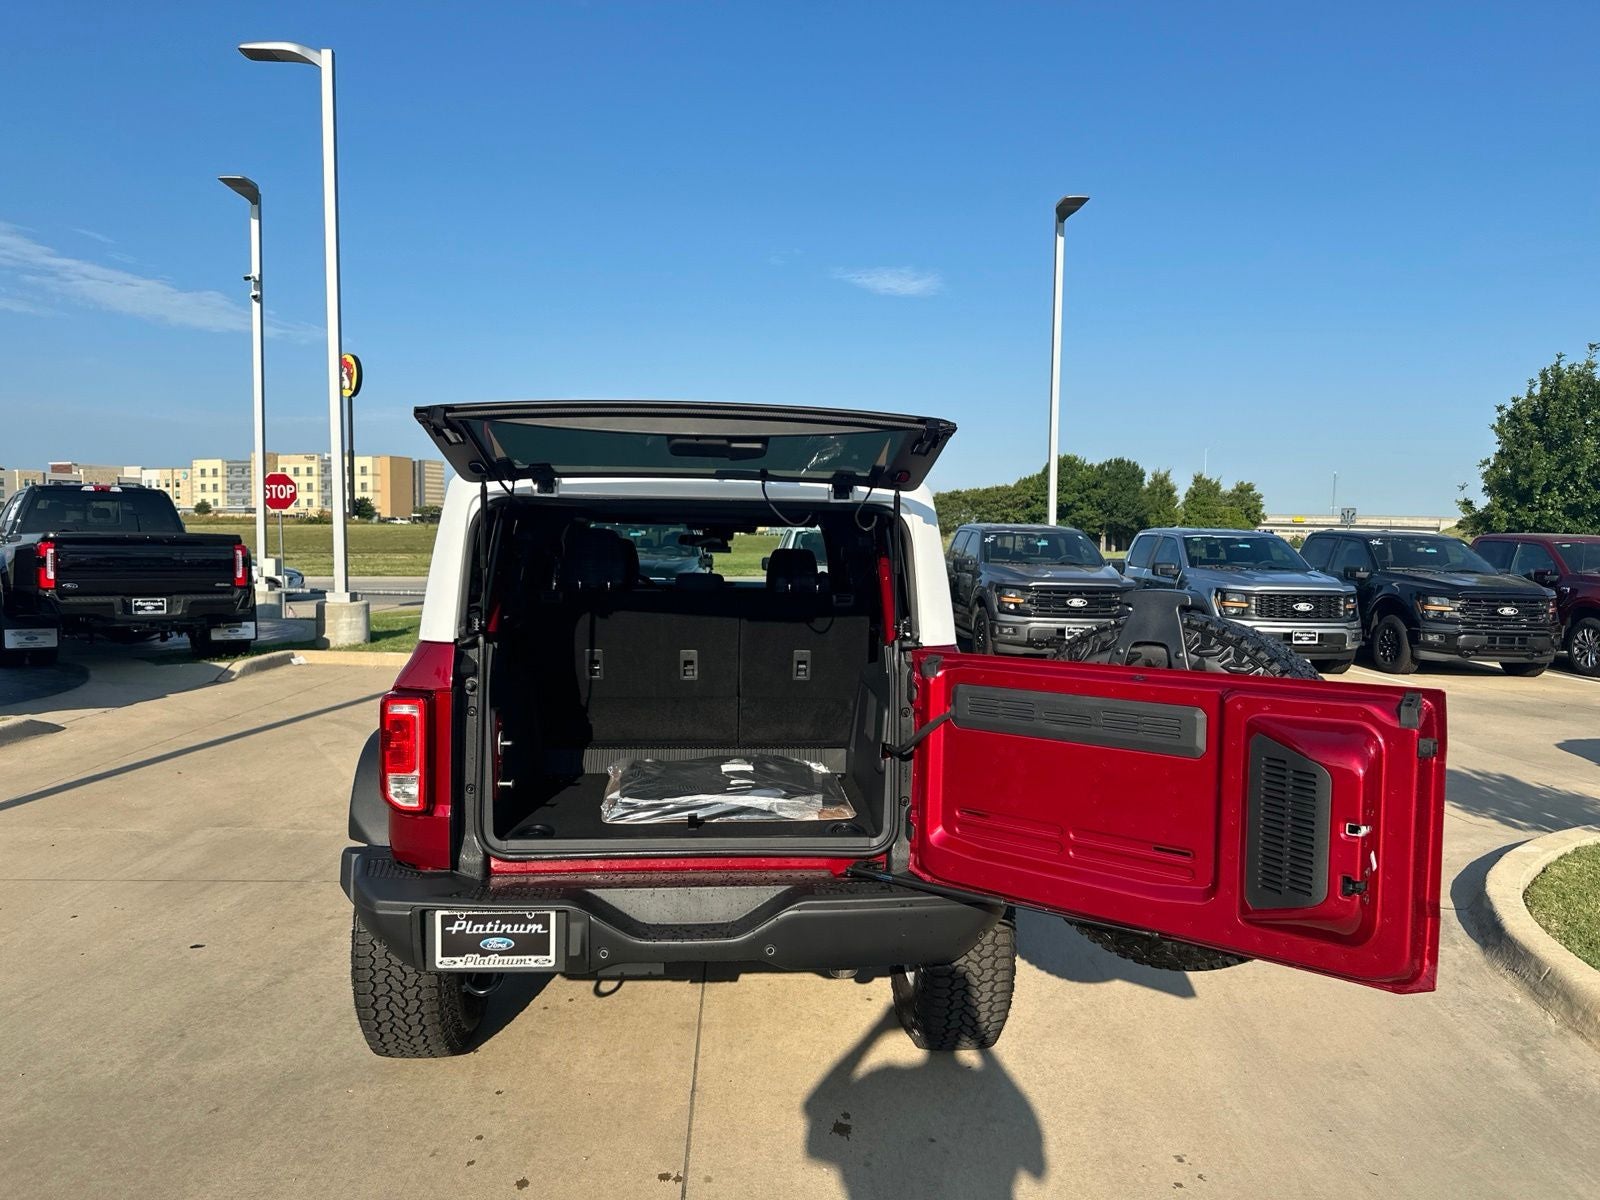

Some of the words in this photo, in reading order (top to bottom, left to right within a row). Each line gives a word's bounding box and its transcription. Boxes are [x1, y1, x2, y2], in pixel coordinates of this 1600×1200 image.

[265, 485, 295, 499] STOP
[445, 920, 548, 934] Platinum
[484, 939, 510, 950] Ford
[464, 954, 527, 966] Platinum
